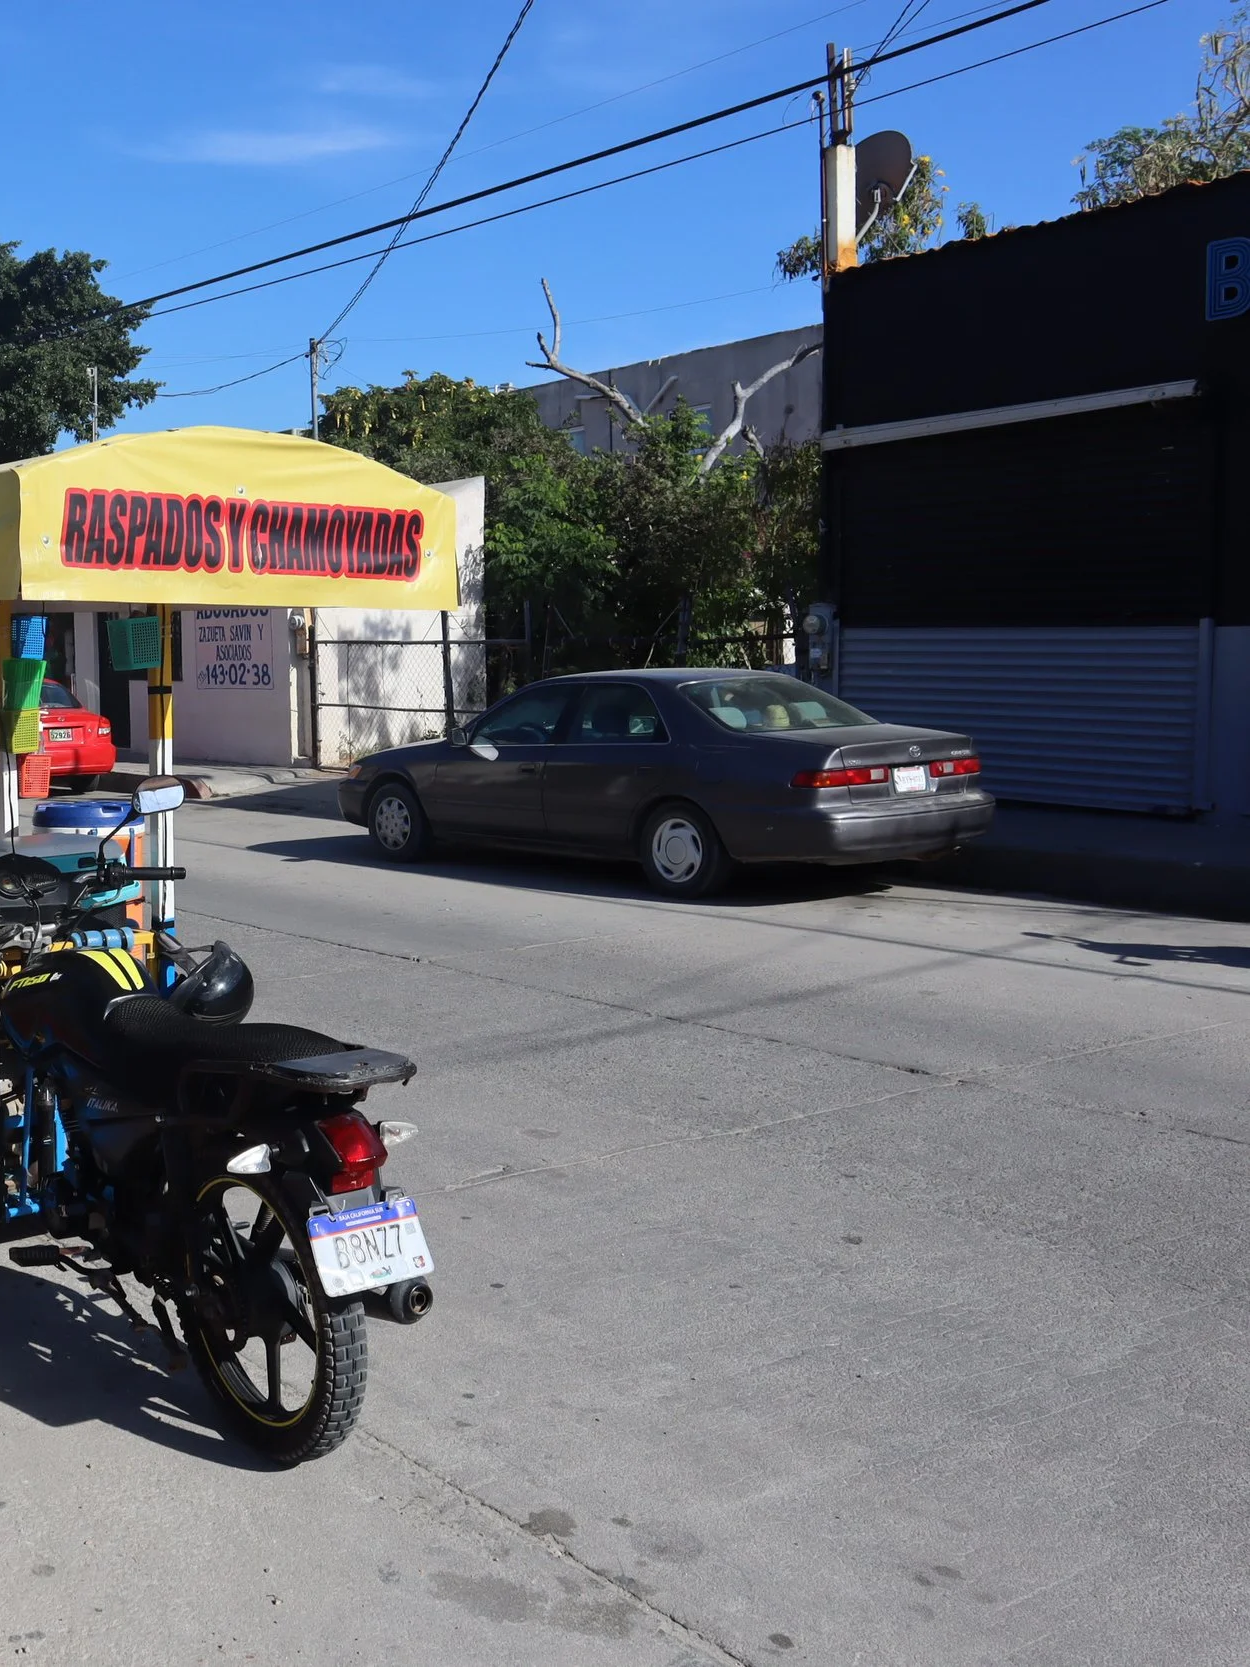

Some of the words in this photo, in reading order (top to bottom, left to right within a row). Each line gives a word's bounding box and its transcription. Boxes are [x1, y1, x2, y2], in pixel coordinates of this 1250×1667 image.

[61, 489, 224, 572] RASPADOS
[225, 497, 250, 572] Y
[249, 499, 424, 582] CHAMOYADAS
[198, 625, 226, 642] ZAZUETA
[230, 624, 251, 641] SAVIN
[257, 623, 264, 641] Y
[216, 644, 252, 661] ASOCIADOS
[338, 1213, 350, 1221] BAJA
[350, 1208, 375, 1219] CALIFORNIA
[333, 1224, 402, 1269] B8NZ7
